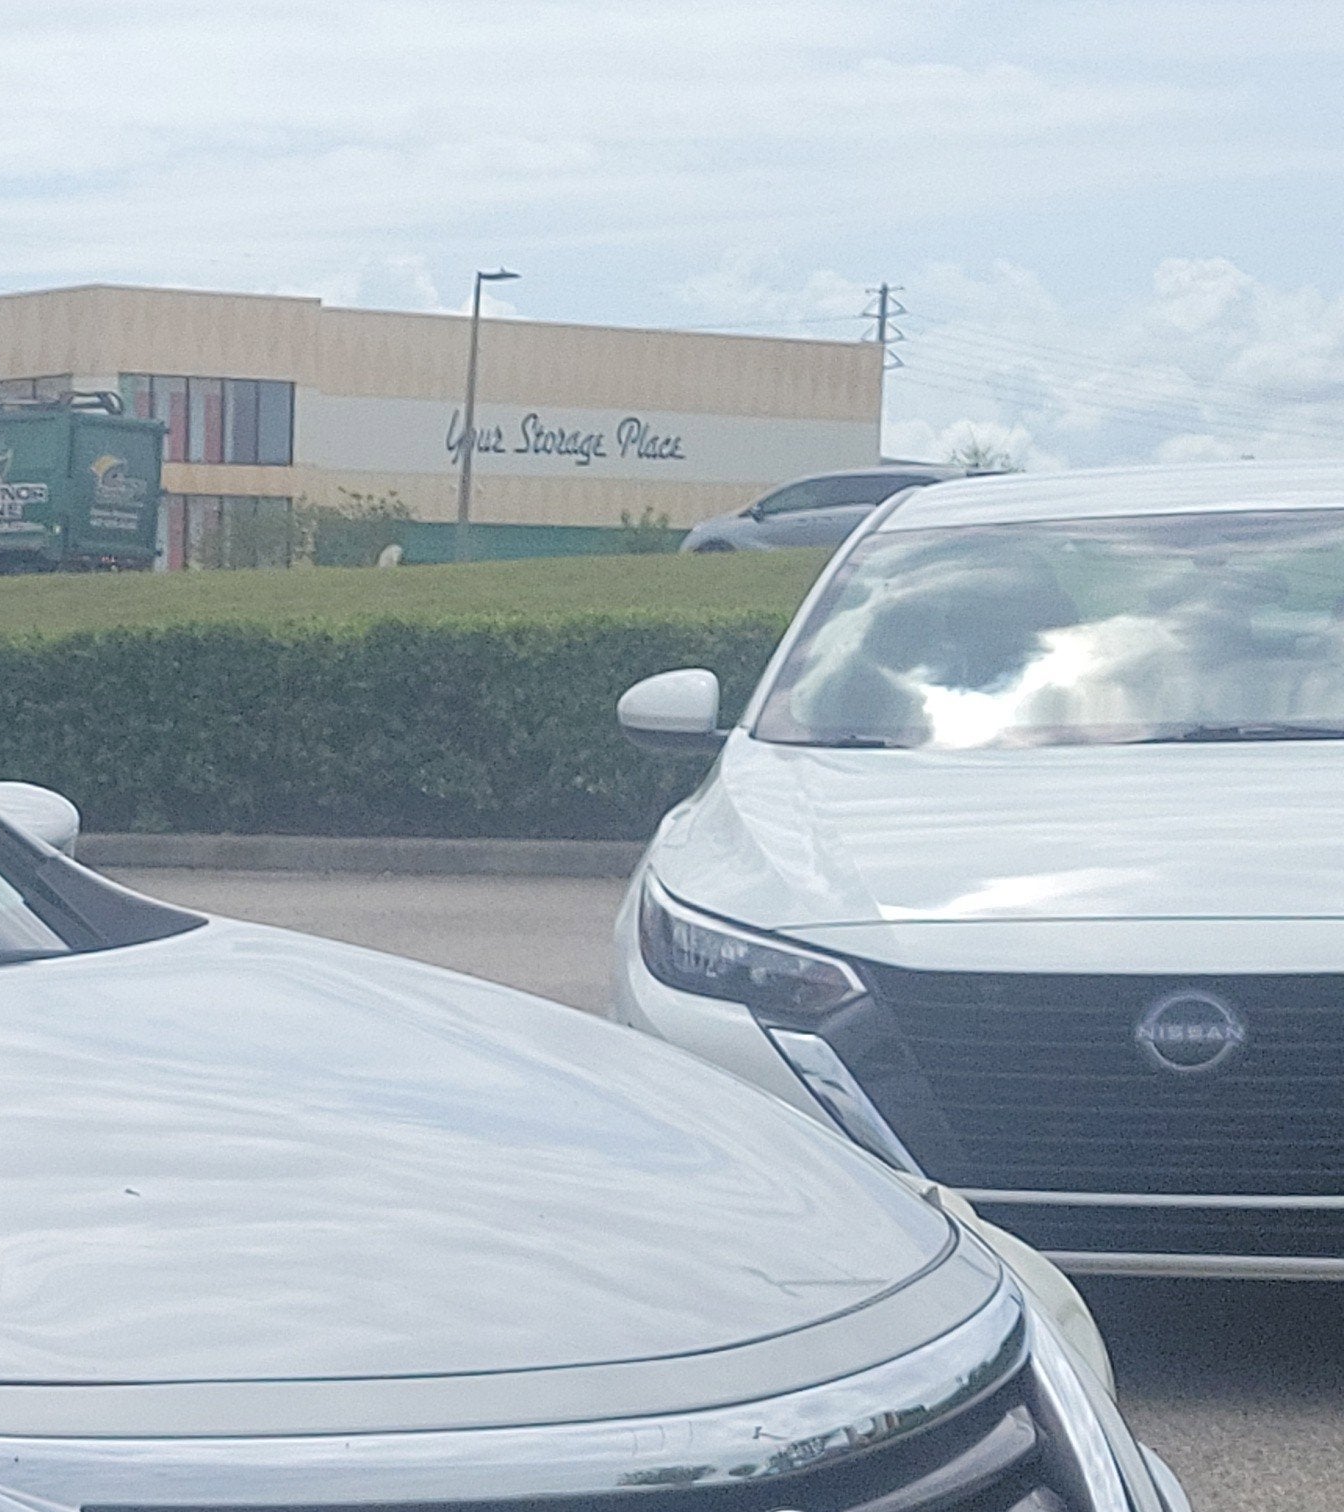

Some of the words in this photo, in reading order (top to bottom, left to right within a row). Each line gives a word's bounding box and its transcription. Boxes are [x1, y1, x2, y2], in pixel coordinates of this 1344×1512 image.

[514, 413, 607, 466] Storage
[617, 417, 685, 460] Place
[1136, 1025, 1244, 1042] NISSAN
